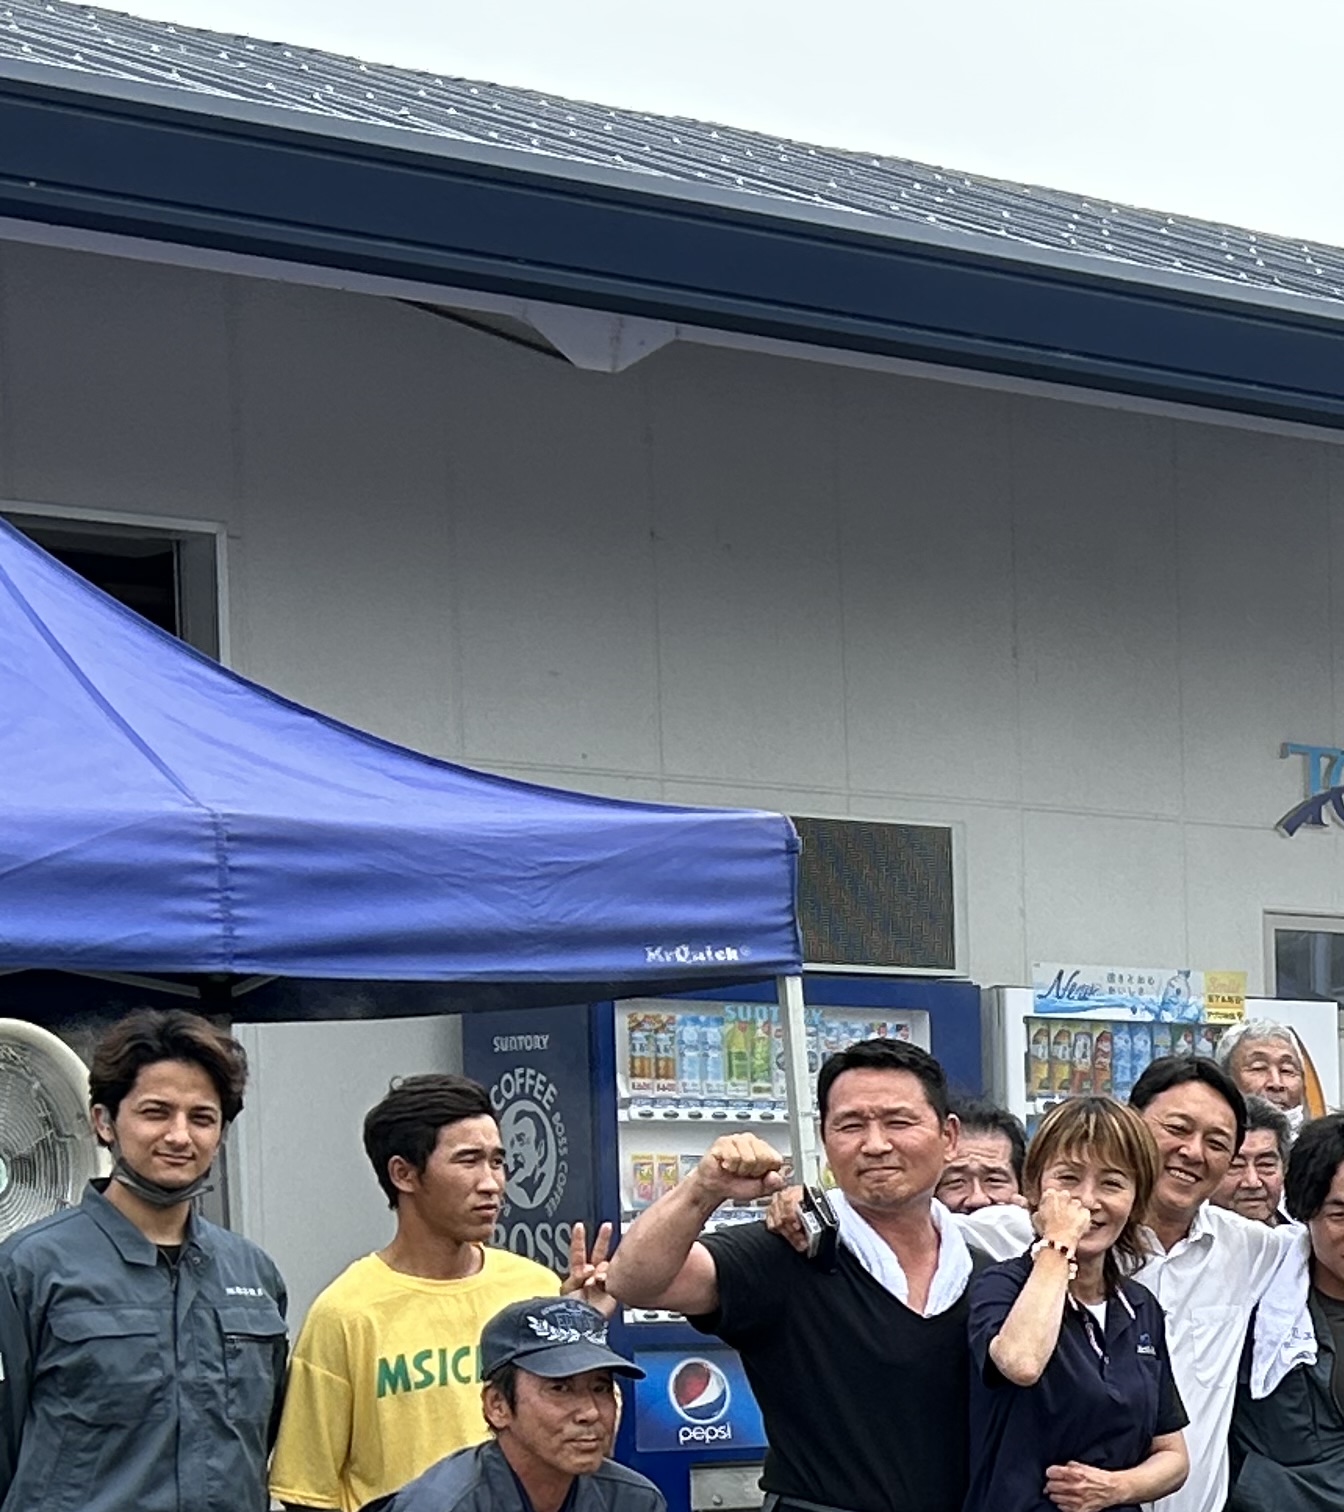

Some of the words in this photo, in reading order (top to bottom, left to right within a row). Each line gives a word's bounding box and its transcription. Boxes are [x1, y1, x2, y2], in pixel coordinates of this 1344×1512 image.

[493, 1034, 550, 1052] SUNTORY
[490, 1067, 558, 1111] COFFEE
[551, 1111, 568, 1157] BOSS
[545, 1159, 569, 1218] COFFEE
[679, 1421, 732, 1445] pepsi
